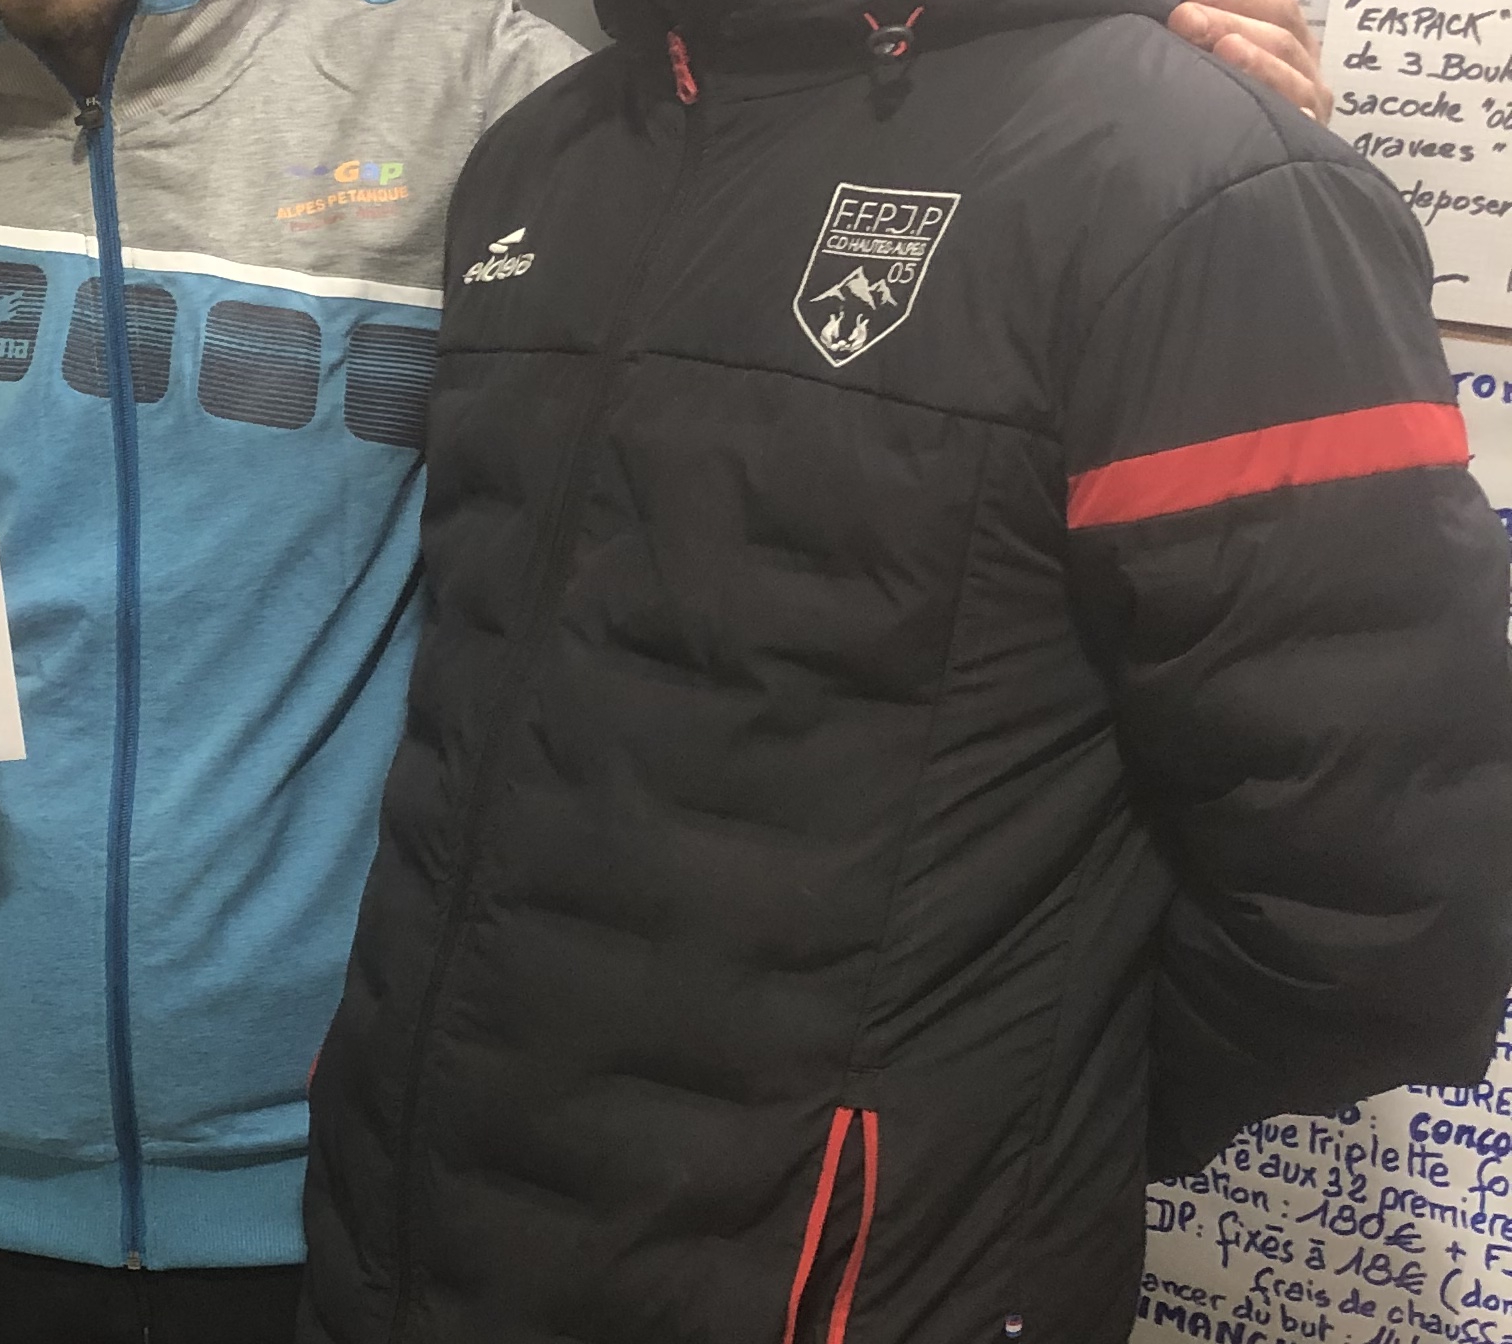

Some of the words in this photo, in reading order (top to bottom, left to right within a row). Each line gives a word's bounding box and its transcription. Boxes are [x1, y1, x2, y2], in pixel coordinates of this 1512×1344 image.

[1343, 40, 1383, 71] de
[1397, 51, 1423, 76] 3
[887, 261, 918, 284] 05
[1237, 1119, 1299, 1155] que
[1309, 1120, 1451, 1188] triplette
[1256, 1152, 1318, 1190] aux
[1321, 1166, 1368, 1204] 32
[1231, 1295, 1271, 1326] du
[1280, 1303, 1335, 1343] but
[1337, 1287, 1377, 1319] de
